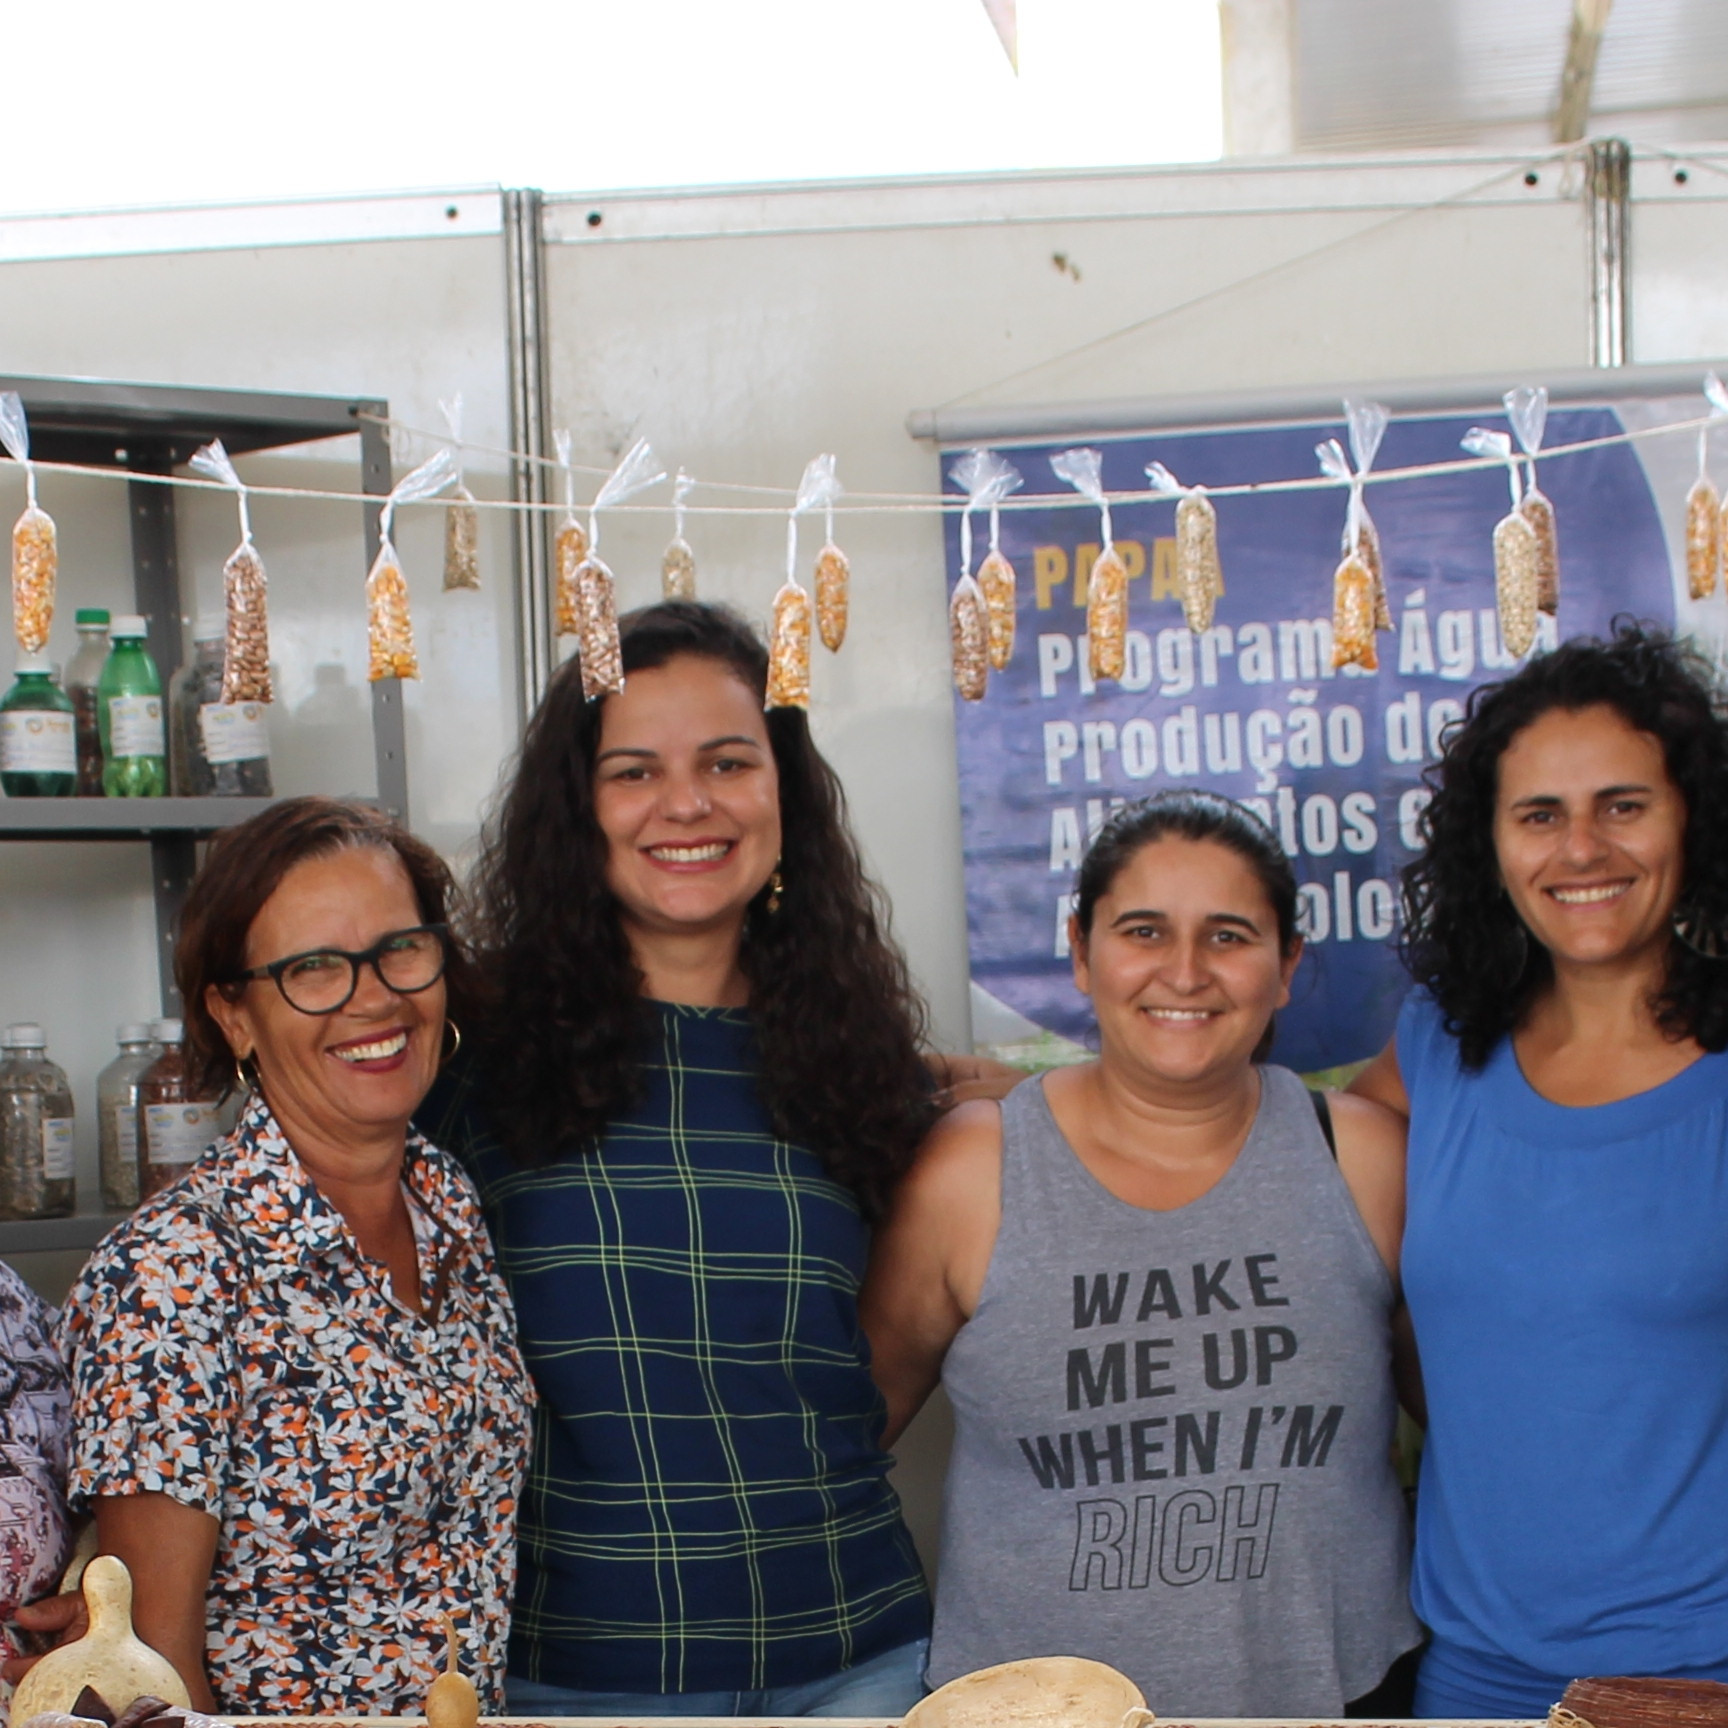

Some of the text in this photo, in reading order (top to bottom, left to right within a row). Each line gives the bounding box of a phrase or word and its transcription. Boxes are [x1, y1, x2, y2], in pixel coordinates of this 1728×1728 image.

[1042, 689, 1364, 793] Produção
[1073, 1253, 1291, 1330] WAKE
[1066, 1325, 1298, 1411] ME UP
[1018, 1404, 1345, 1490] WHEN I'M
[1068, 1482, 1281, 1591] RICH
